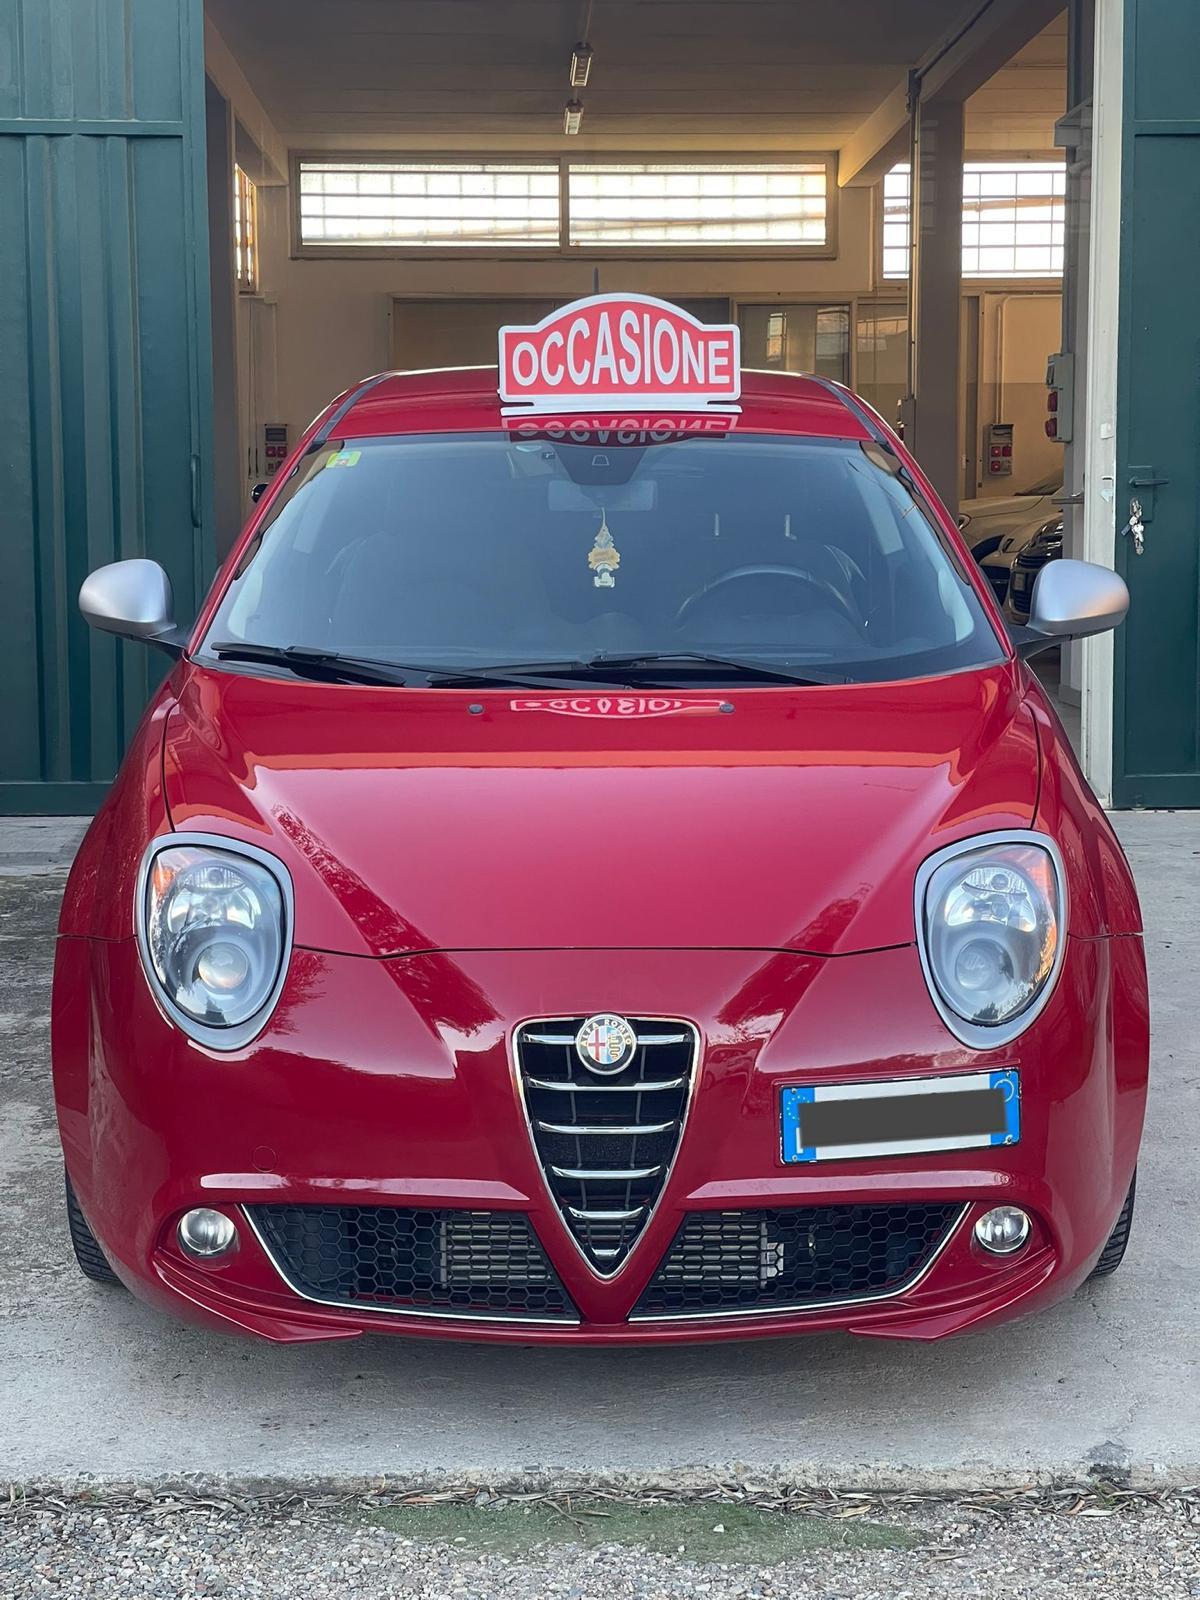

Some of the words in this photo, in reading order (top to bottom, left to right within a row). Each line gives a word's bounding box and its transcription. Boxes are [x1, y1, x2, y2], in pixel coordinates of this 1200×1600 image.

[512, 309, 730, 386] OCCASIONE
[580, 1022, 599, 1047] ALFA
[604, 1019, 632, 1045] ROMEO
